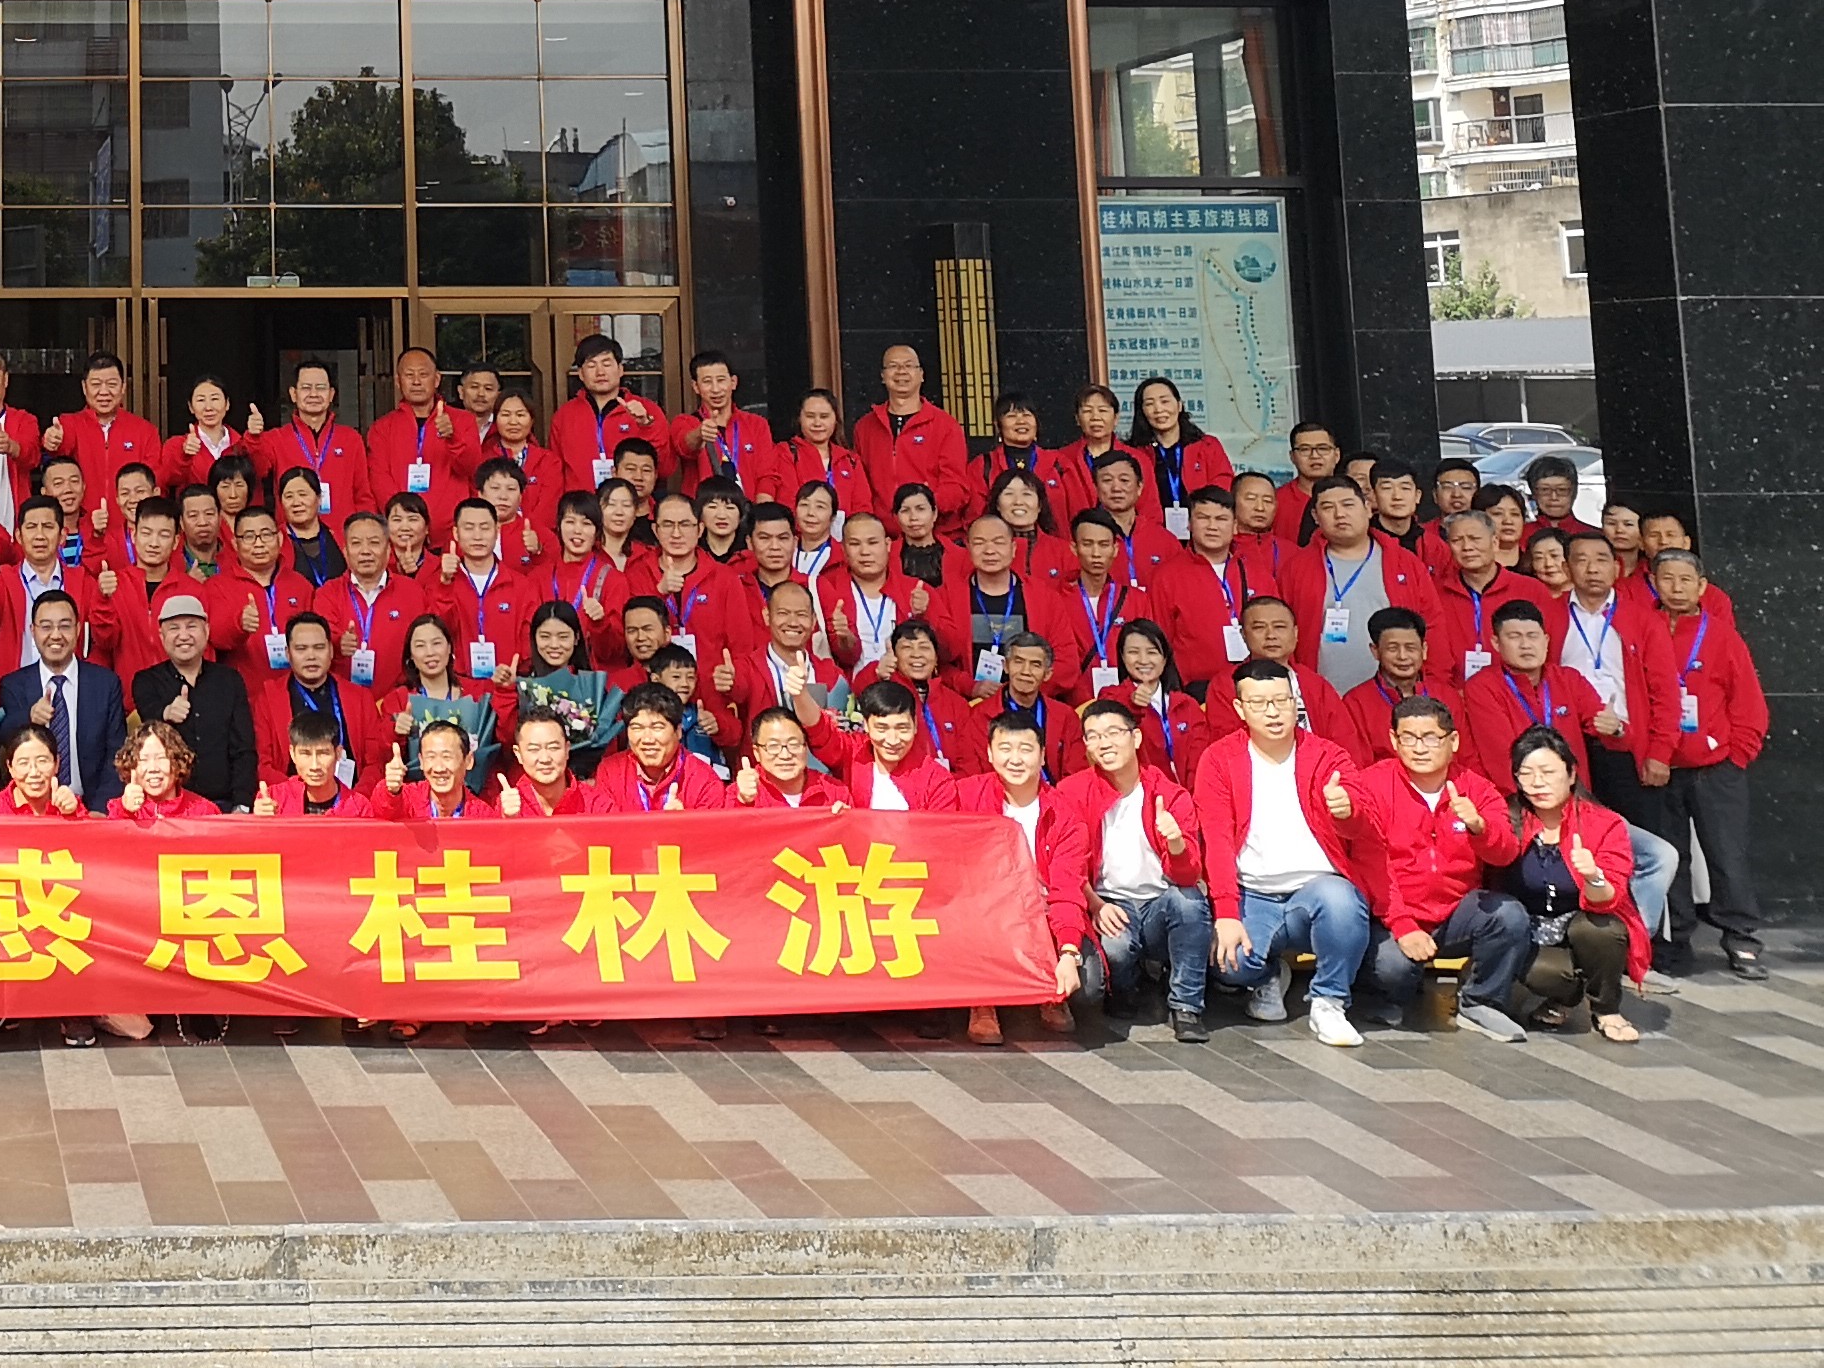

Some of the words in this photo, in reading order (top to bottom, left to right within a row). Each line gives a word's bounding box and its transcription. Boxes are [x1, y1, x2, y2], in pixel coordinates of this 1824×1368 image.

[1102, 208, 1270, 229] 桂林阳朔主要旅游线路
